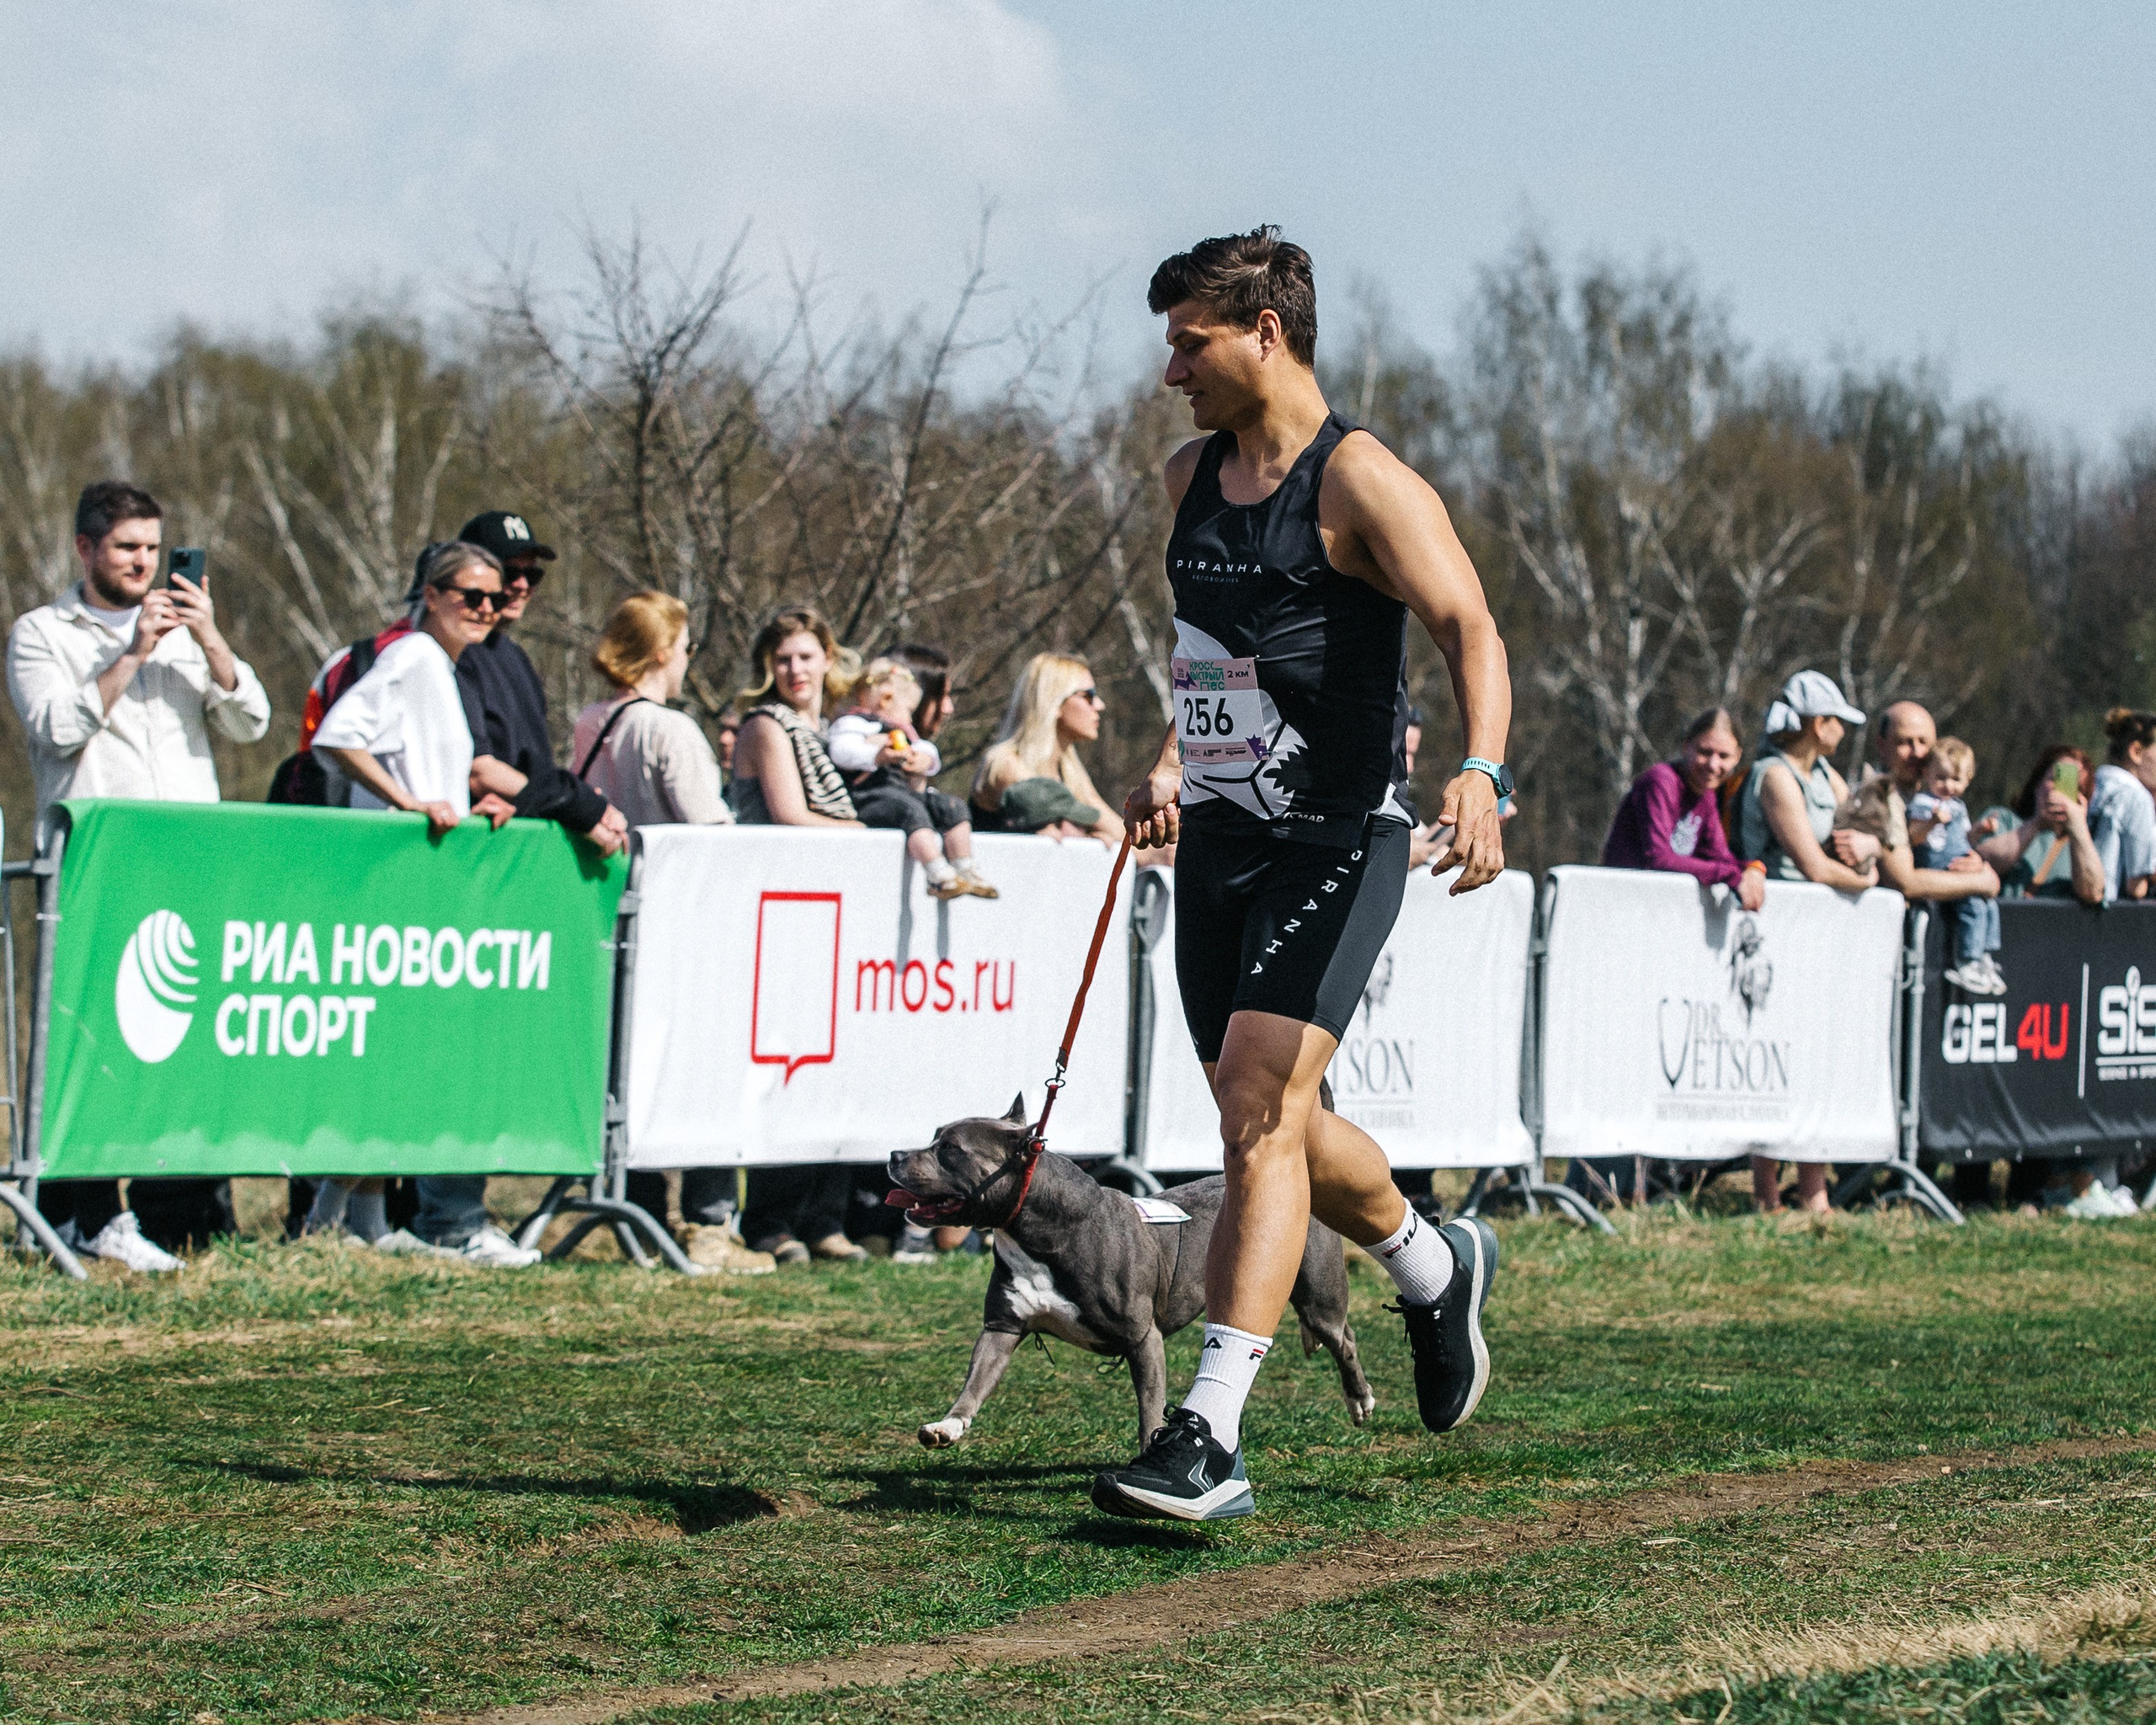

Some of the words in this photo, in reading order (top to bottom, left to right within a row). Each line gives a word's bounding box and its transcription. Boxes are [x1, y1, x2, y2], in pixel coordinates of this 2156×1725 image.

[1177, 559, 1262, 574] PIRANHA
[1184, 697, 1233, 736] 256
[221, 921, 320, 985] РИА
[330, 923, 552, 991] НОВОСТИ
[856, 959, 1015, 1012] mos.ru
[214, 993, 376, 1058] СПОРТ
[1942, 1002, 2069, 1064] GEL4U
